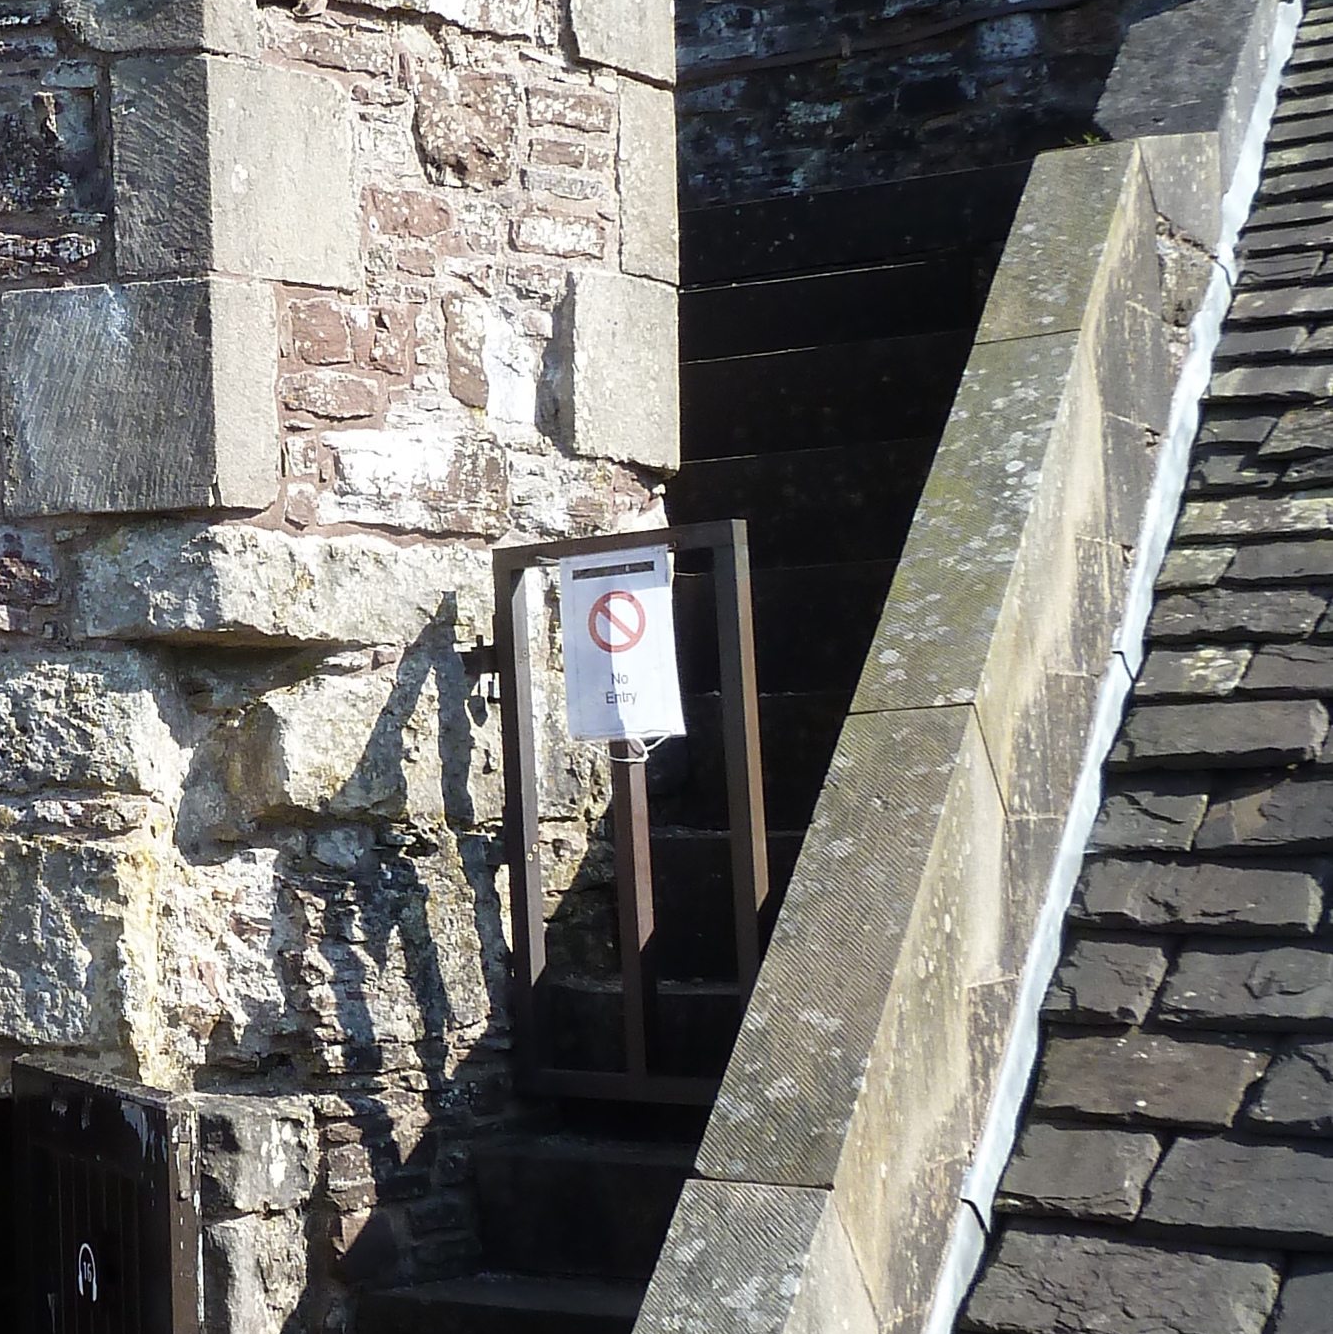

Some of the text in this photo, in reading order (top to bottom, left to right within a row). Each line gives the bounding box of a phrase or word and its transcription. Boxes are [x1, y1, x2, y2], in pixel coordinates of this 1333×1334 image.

[611, 672, 629, 684] No
[606, 691, 637, 704] Entry
[83, 1261, 92, 1283] 16
